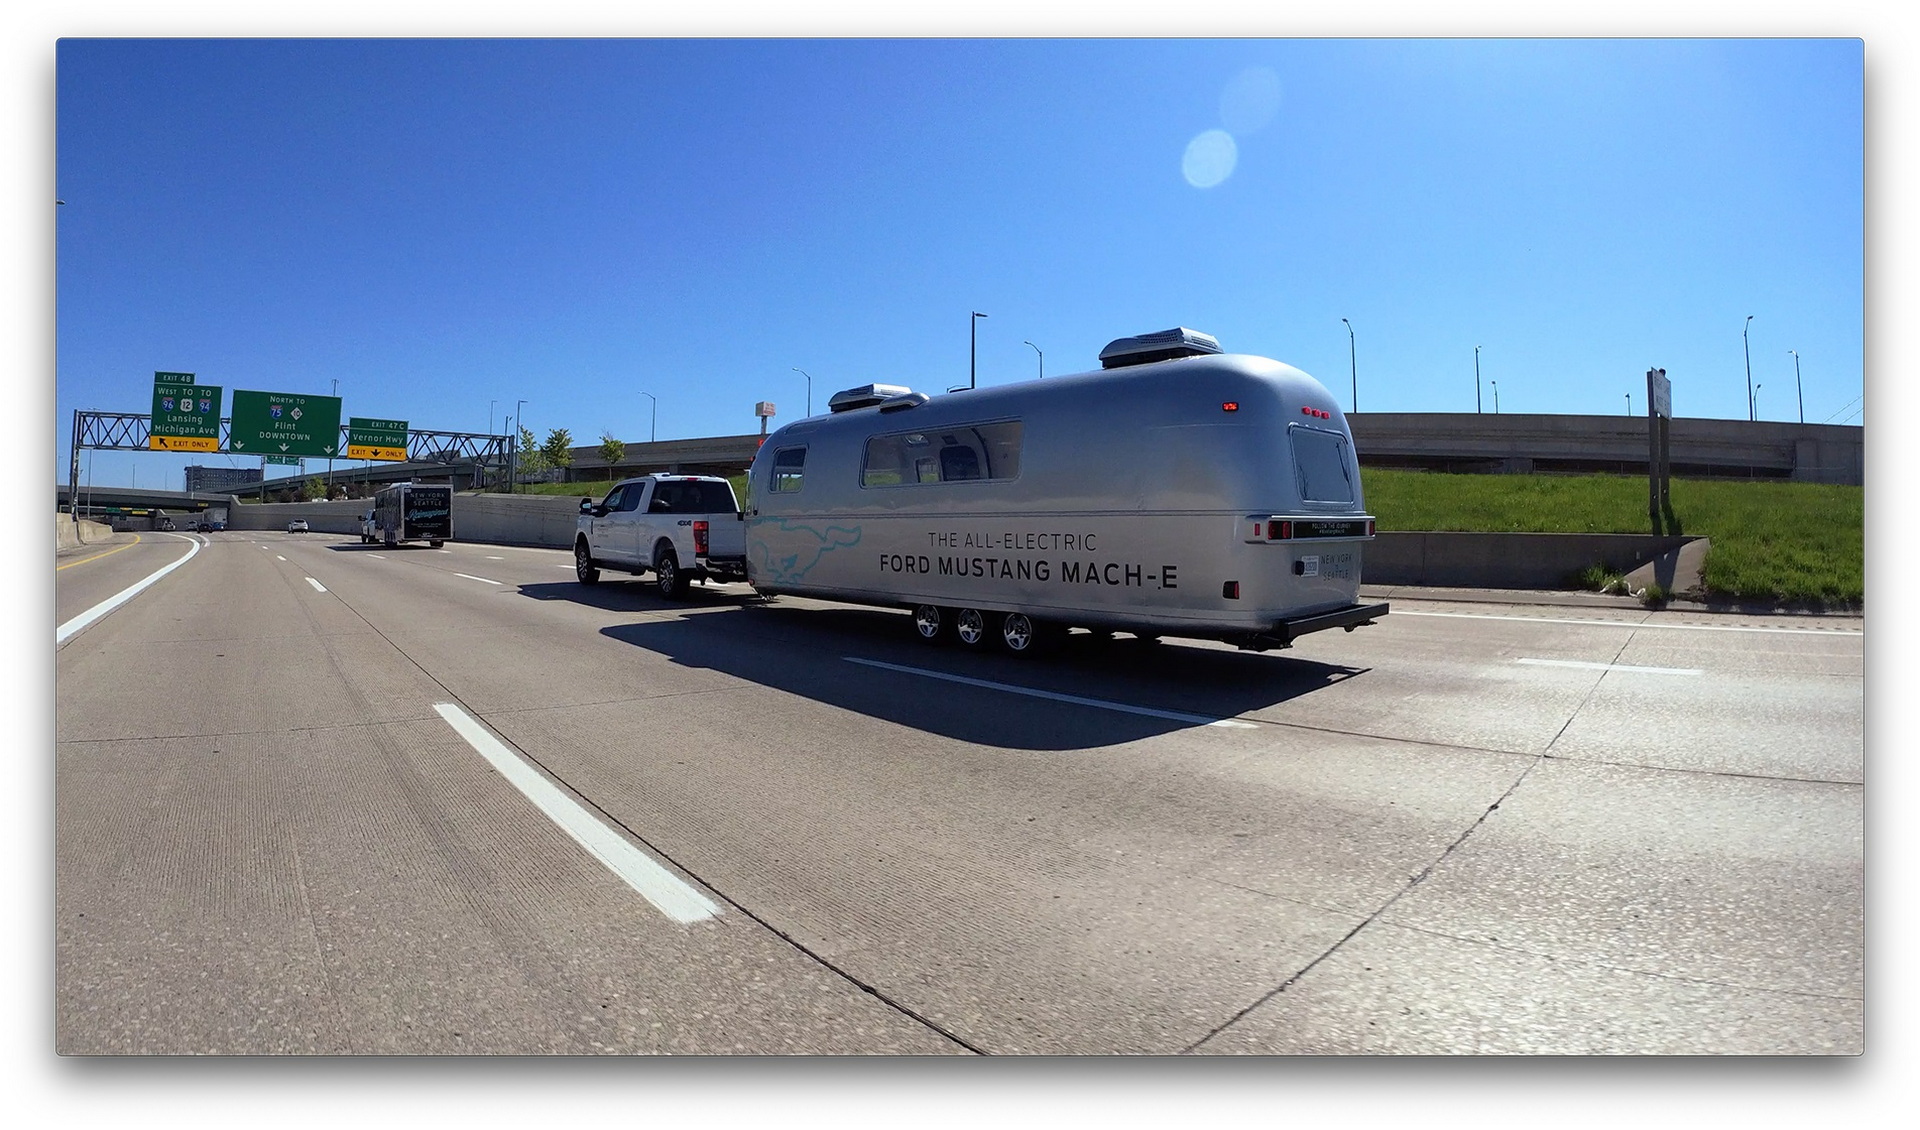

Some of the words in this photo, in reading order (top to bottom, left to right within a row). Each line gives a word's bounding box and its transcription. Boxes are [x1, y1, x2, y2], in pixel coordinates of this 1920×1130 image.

[158, 387, 177, 395] WEST
[162, 401, 174, 409] 96
[183, 401, 190, 409] 12
[200, 402, 209, 410] 94
[271, 408, 281, 416] 75
[167, 415, 203, 424] Lansing
[154, 425, 195, 435] Michigan
[198, 426, 215, 434] Ave
[275, 421, 296, 430] Flint
[260, 431, 310, 440] DOWNTOWN
[353, 433, 383, 441] Vernor
[385, 436, 404, 444] Hwy
[928, 532, 957, 547] THE
[964, 532, 1097, 551] ALL-ELECTRIC
[880, 554, 930, 574] FORD
[938, 556, 1050, 582] MUSTANG
[1061, 561, 1178, 590] MACH-E
